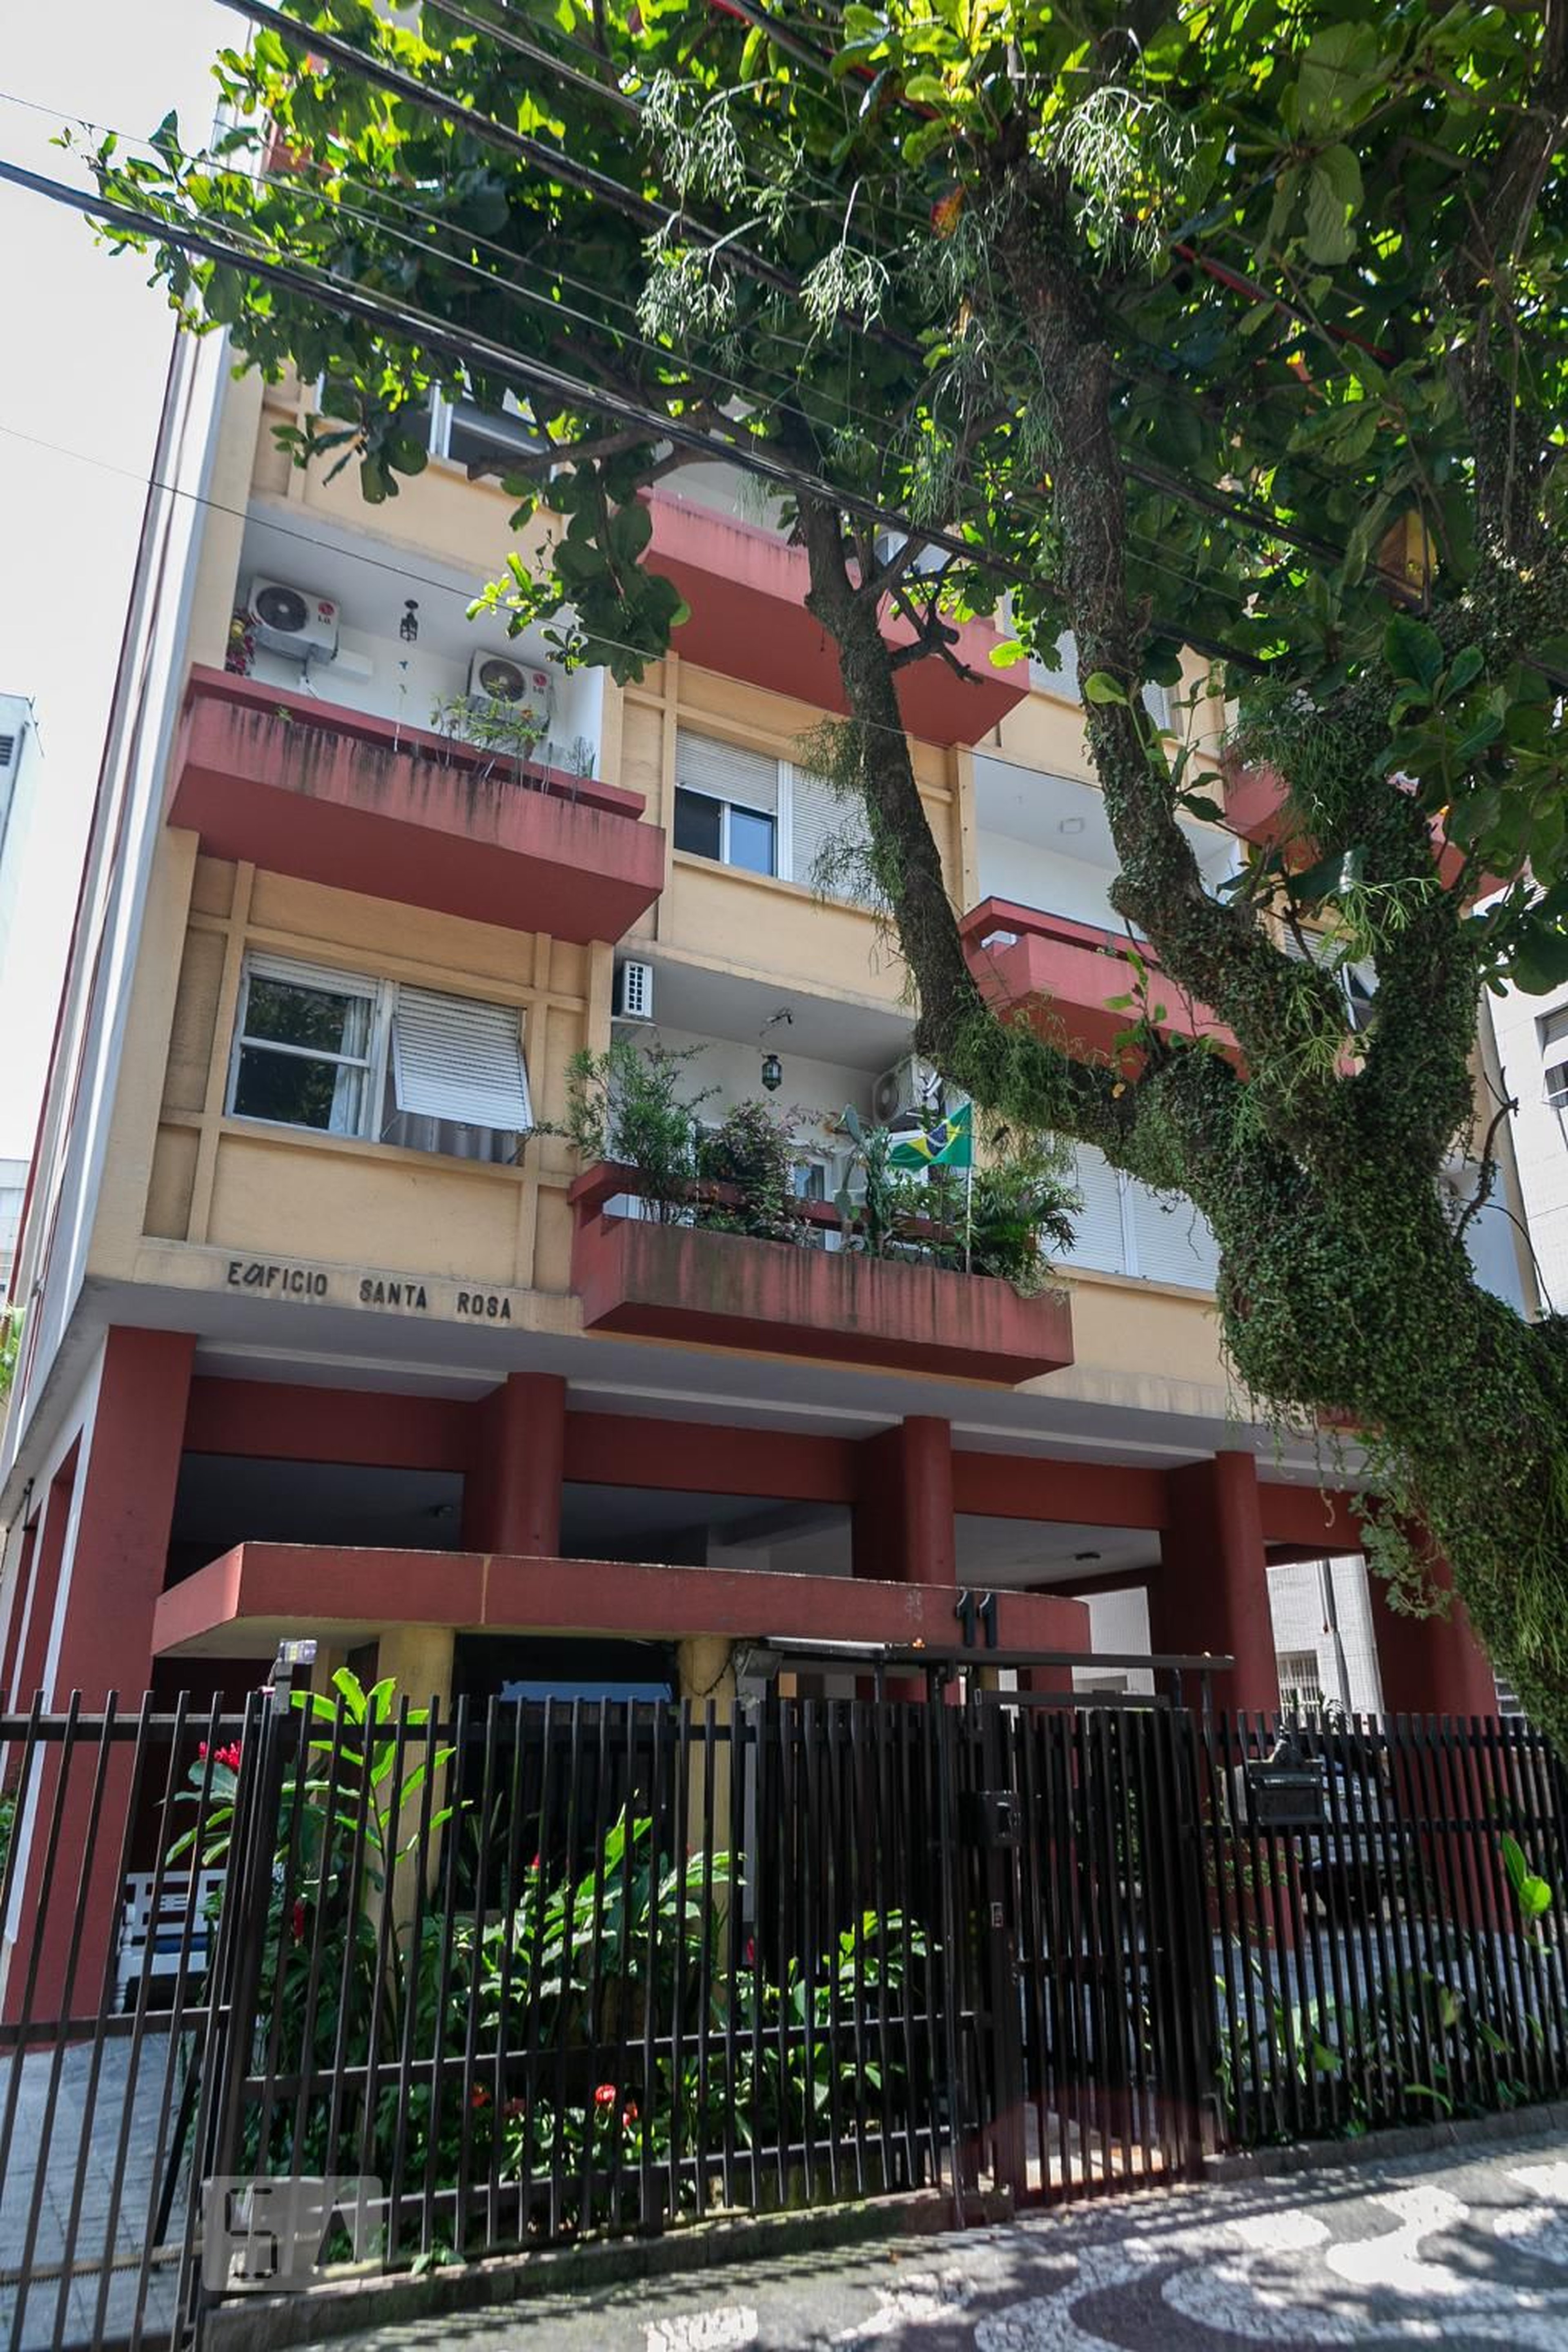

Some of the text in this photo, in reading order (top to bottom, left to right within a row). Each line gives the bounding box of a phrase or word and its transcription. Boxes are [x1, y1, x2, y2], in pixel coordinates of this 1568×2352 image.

[228, 1261, 511, 1319] EDIFICIO SANTA ROSA
[955, 1590, 997, 1648] 11
